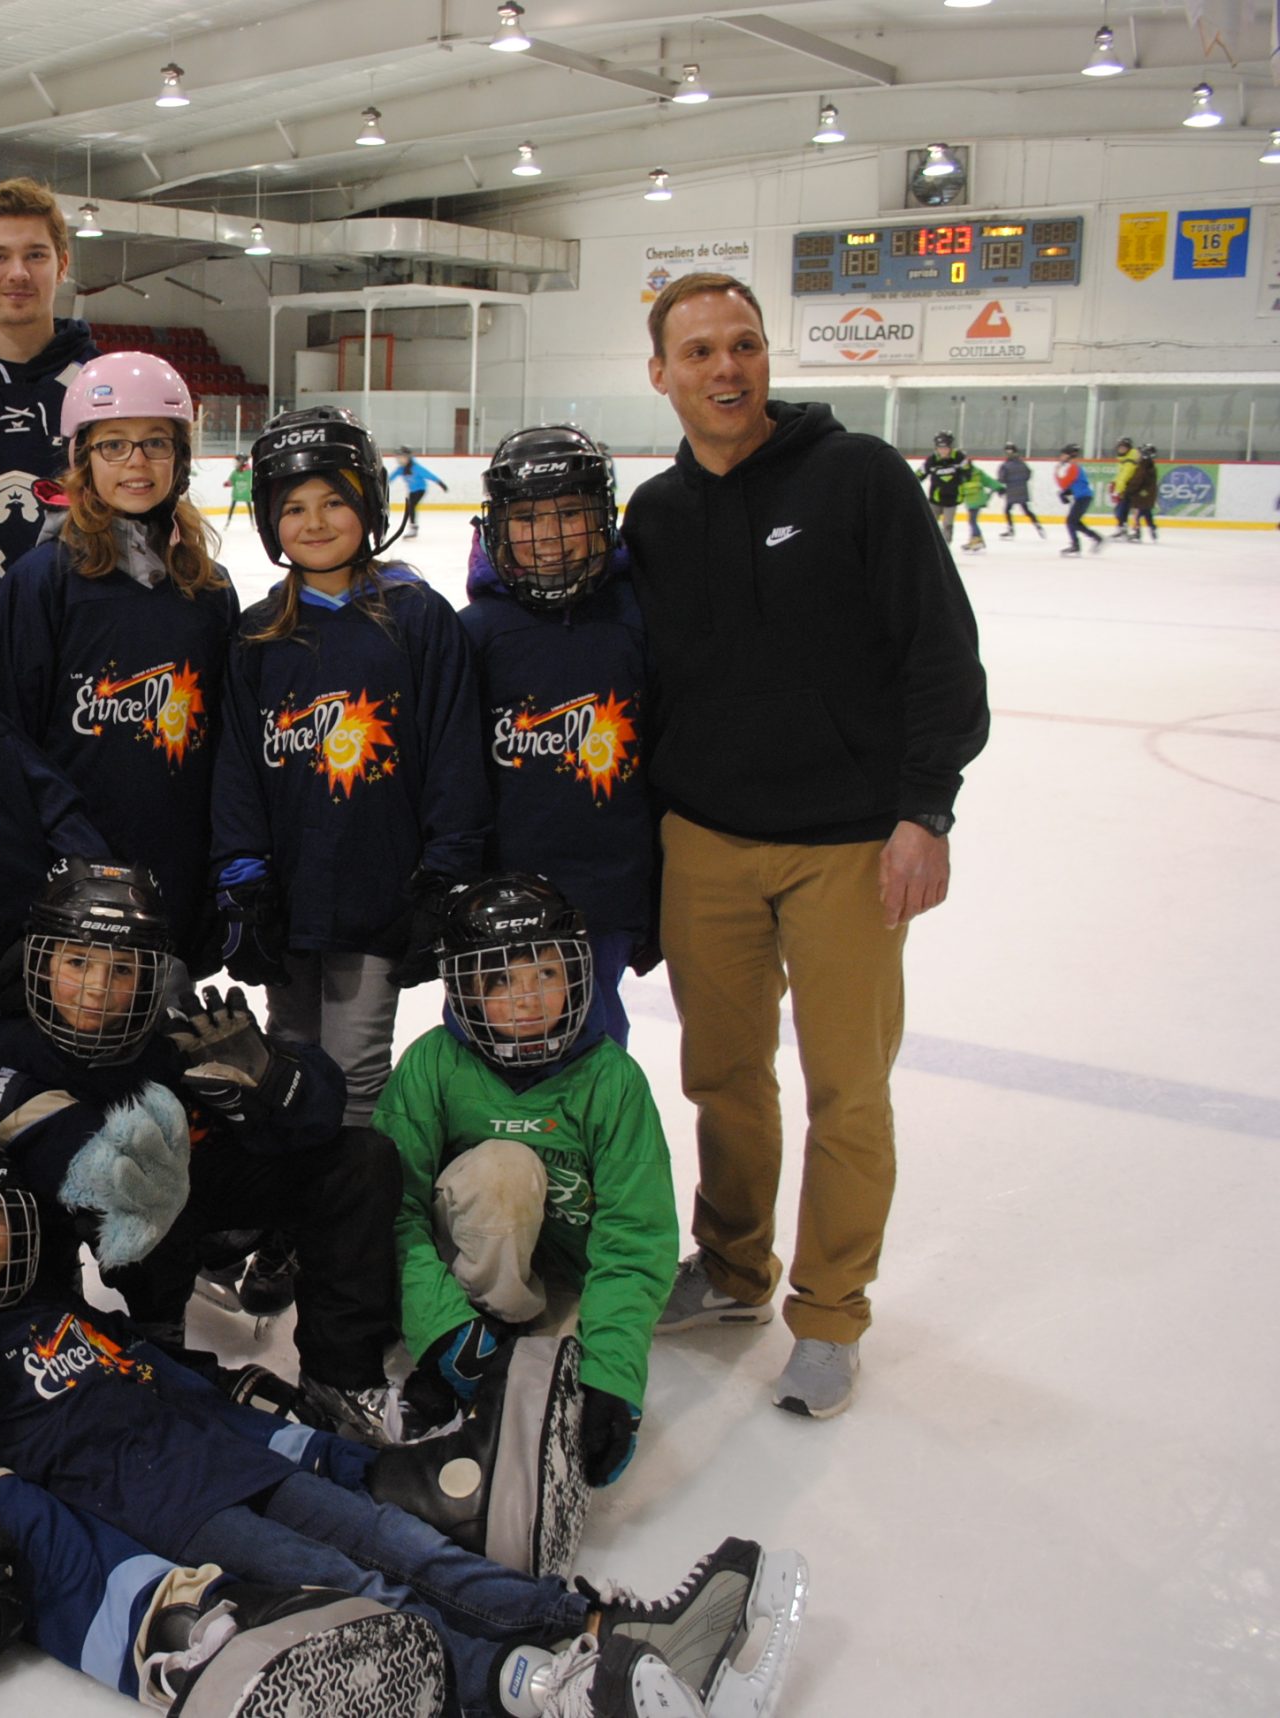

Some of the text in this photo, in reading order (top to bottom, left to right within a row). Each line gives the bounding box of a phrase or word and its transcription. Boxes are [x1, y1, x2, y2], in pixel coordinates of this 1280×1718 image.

[917, 225, 973, 256] 1:23
[1202, 234, 1222, 250] 16
[646, 241, 749, 260] Chevaliers de Colomb
[950, 260, 966, 283] 0
[808, 323, 915, 342] COUILLARD
[949, 345, 1027, 358] COUILLARD
[273, 428, 326, 449] JOFA
[517, 461, 568, 477] CCM
[1171, 470, 1203, 485] FM
[771, 525, 794, 539] NIKE
[80, 919, 131, 934] BAUER
[495, 917, 539, 930] CCM
[489, 1118, 543, 1133] TEK
